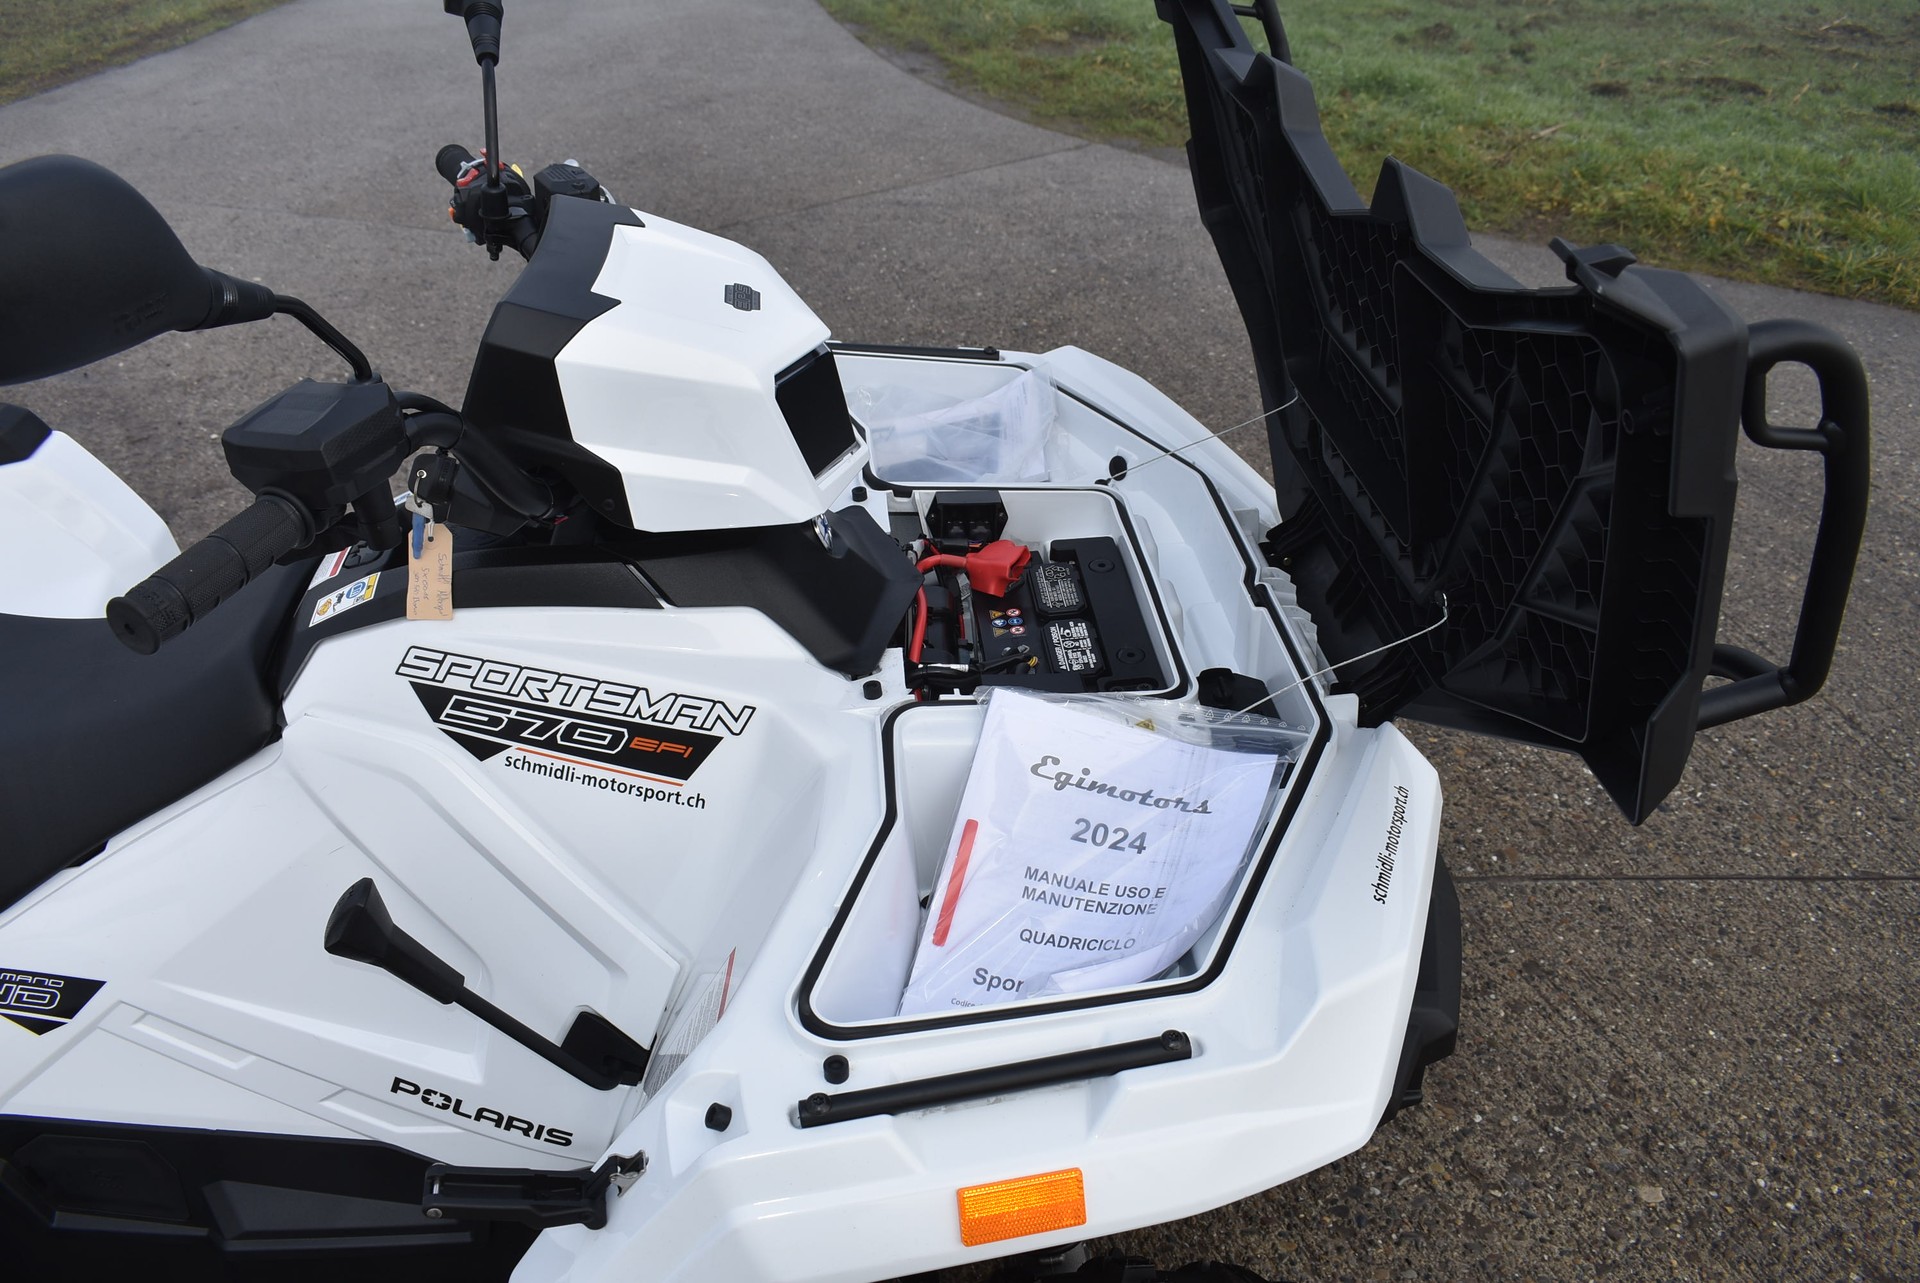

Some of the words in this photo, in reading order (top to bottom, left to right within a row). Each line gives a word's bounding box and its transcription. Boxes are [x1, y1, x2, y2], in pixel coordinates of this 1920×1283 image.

[395, 645, 756, 736] SPORTSMAN
[439, 695, 629, 754] 570
[629, 736, 694, 758] EFI
[504, 754, 706, 810] schmidli-motorsport.ch
[1030, 755, 1212, 815] Egimotors
[1070, 818, 1147, 855] 2024
[1371, 785, 1410, 905] schmidli-motorsport.ch
[1021, 885, 1158, 916] MANUTENZIONE
[1024, 866, 1111, 896] MANUALE
[1115, 885, 1151, 899] USO
[1154, 887, 1167, 899] E
[1019, 928, 1136, 951] QUADRICICLO
[390, 1076, 574, 1147] POLARIS
